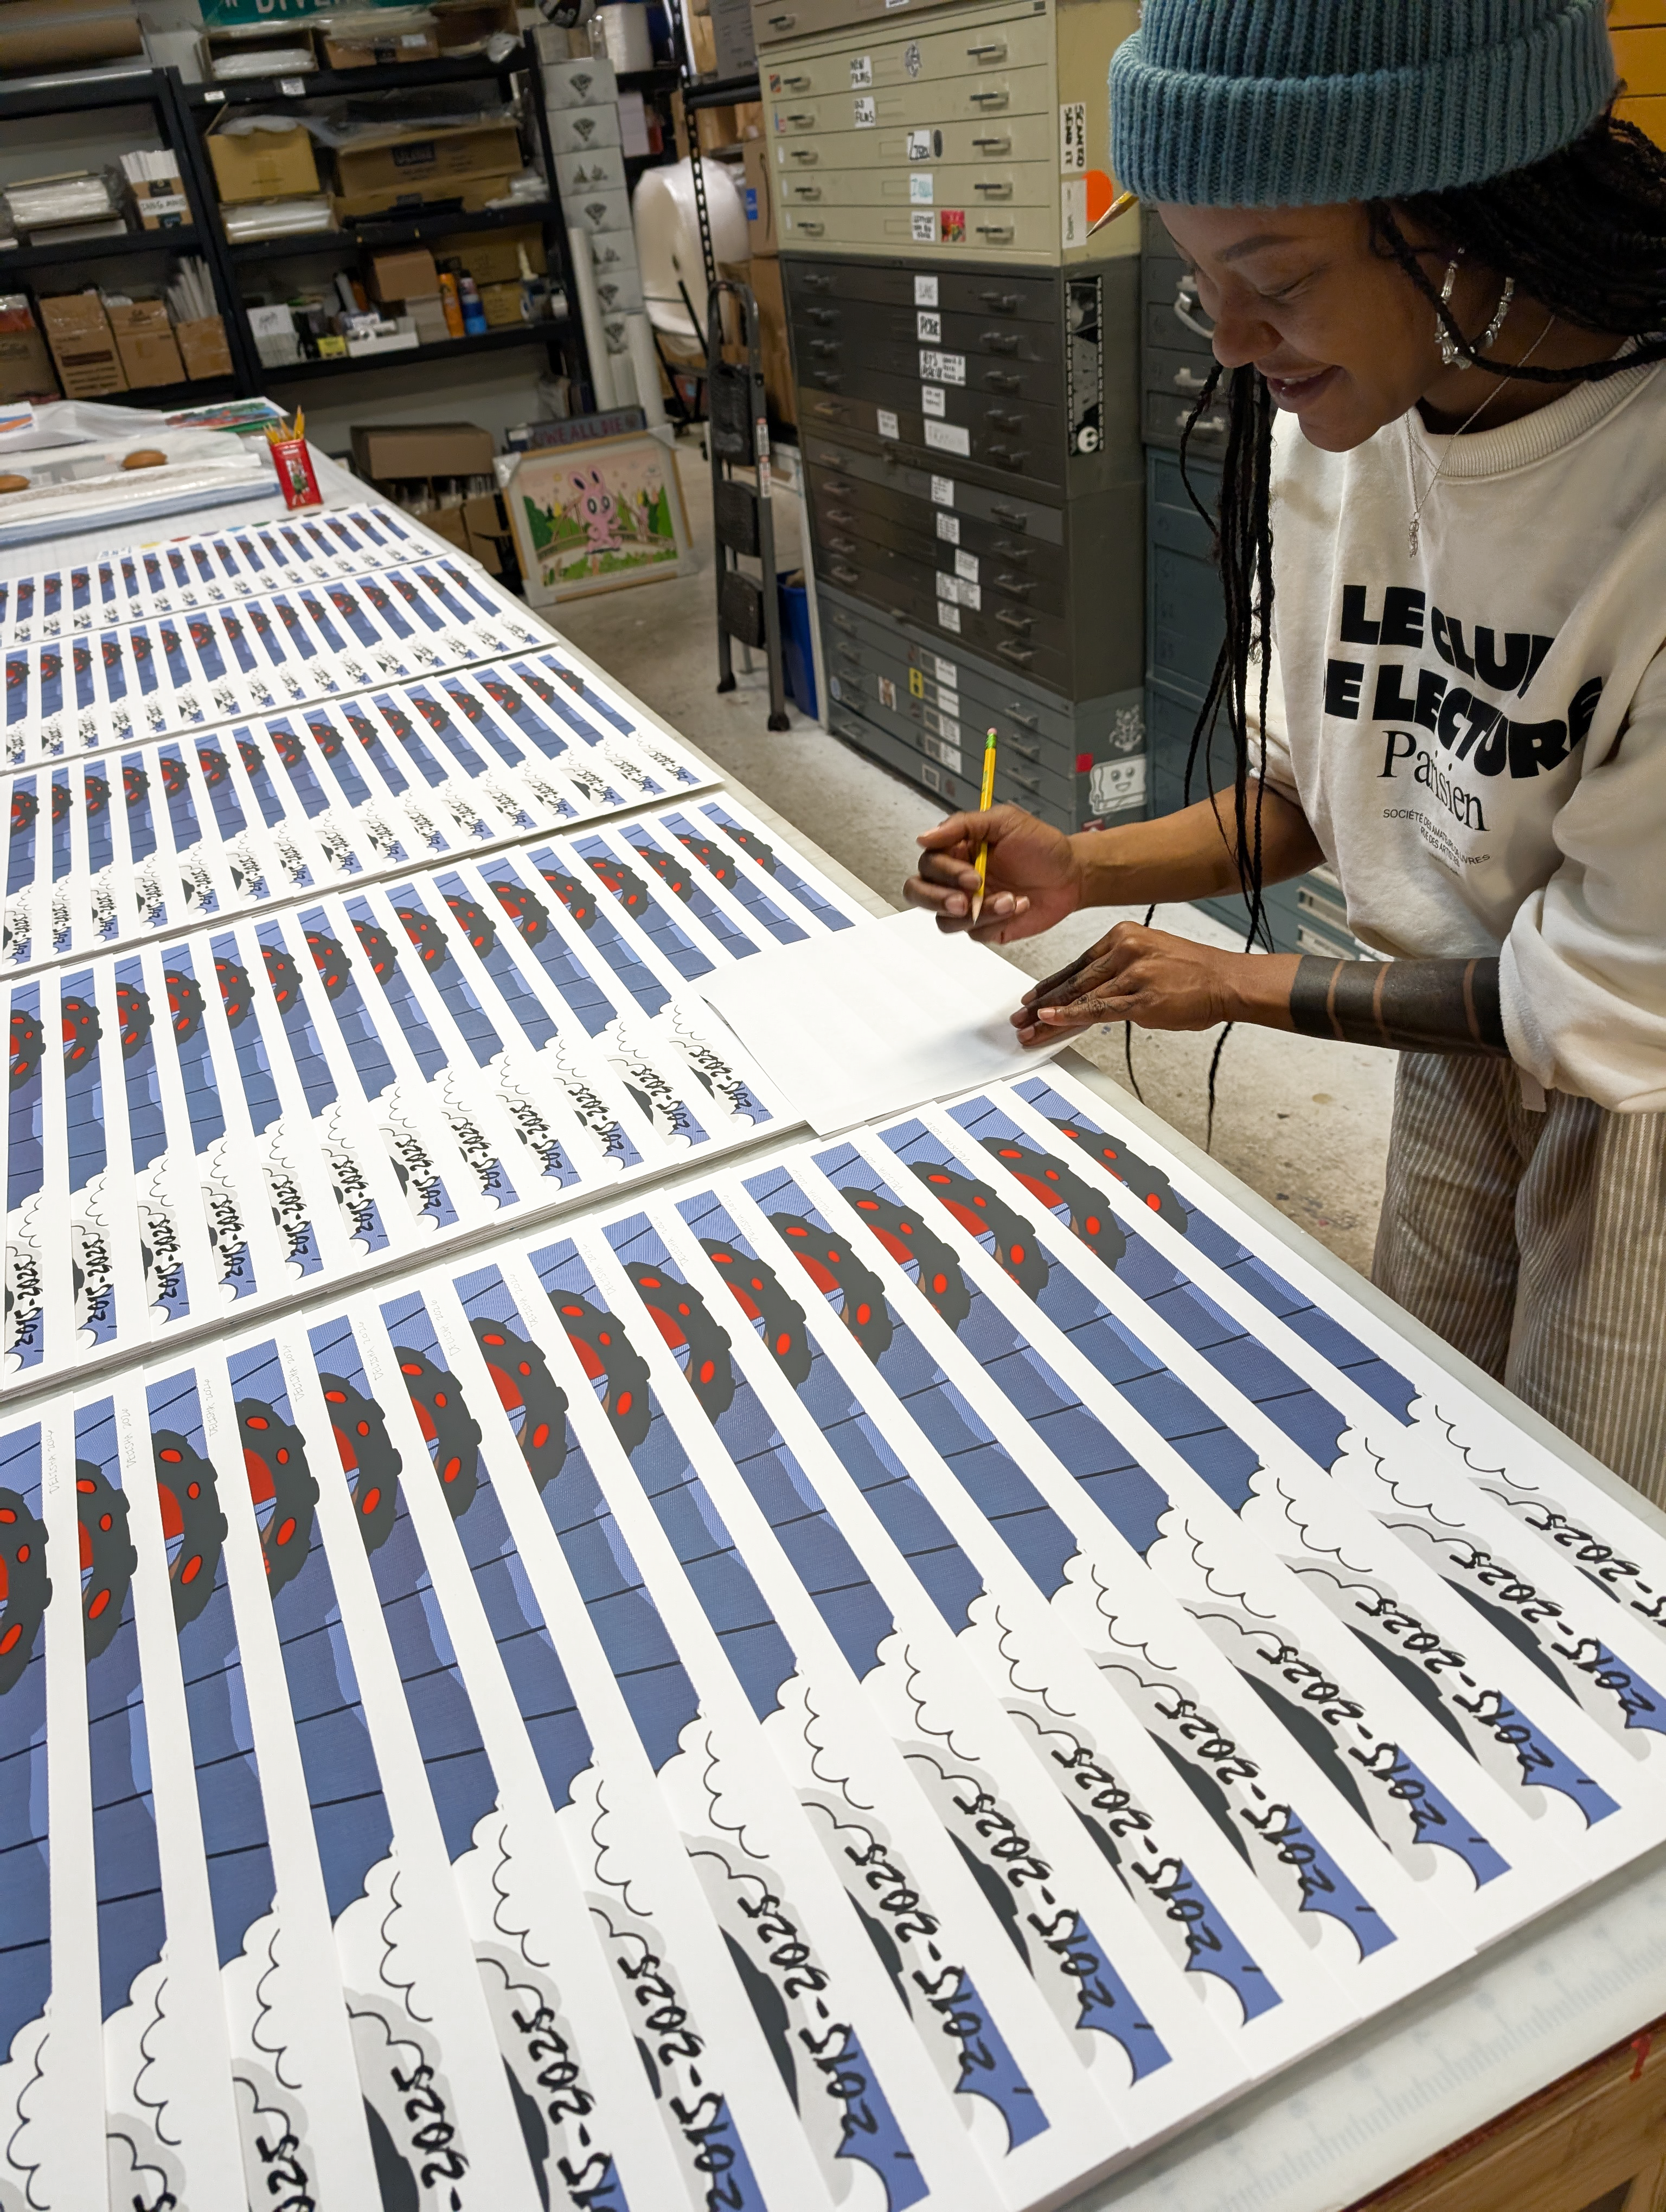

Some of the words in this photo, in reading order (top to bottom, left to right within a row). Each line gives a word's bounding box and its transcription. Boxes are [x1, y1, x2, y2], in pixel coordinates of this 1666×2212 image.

[1323, 658, 1364, 720] E
[1340, 584, 1425, 649] LE
[1376, 730, 1491, 832] Parisien
[1383, 809, 1423, 824] SOCIÉTÉ
[1449, 1551, 1656, 1715] 2015-2025
[1525, 1514, 1666, 1626] 5-2025
[1257, 1645, 1447, 1830] 2015-2025
[1355, 1598, 1555, 1772] 2015-2025
[1051, 1748, 1223, 1955] 2015-2025
[1154, 1700, 1335, 1898] 2015-2025
[844, 1844, 995, 2074] 2015-2025
[953, 1793, 1116, 2010] 2015-2025
[618, 1954, 744, 2212] 2015-2025
[738, 1894, 879, 2137] 2015-2025
[512, 2008, 616, 2212] 15-2025
